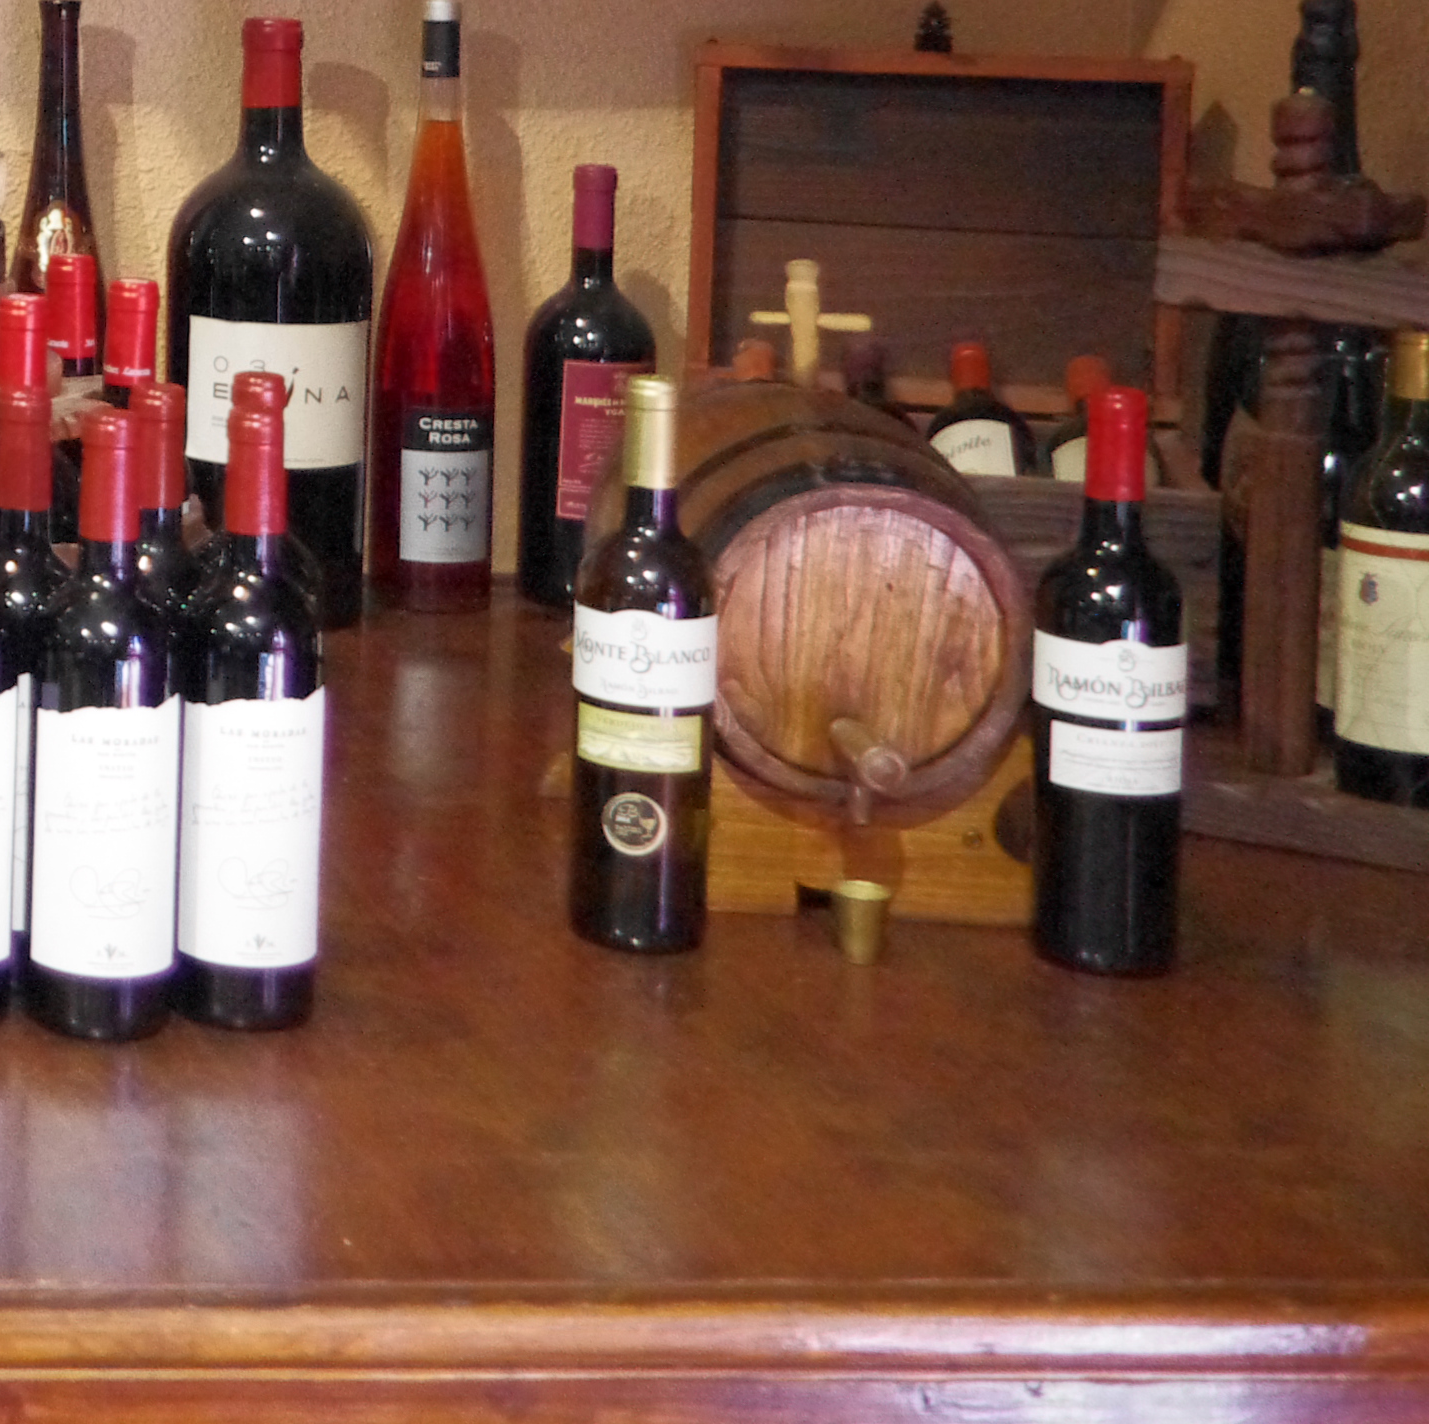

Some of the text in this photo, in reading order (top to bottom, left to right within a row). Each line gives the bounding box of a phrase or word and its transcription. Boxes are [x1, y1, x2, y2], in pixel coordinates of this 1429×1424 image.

[419, 417, 479, 431] CRESTA
[428, 431, 471, 445] ROSA
[629, 640, 711, 674] BLANCO
